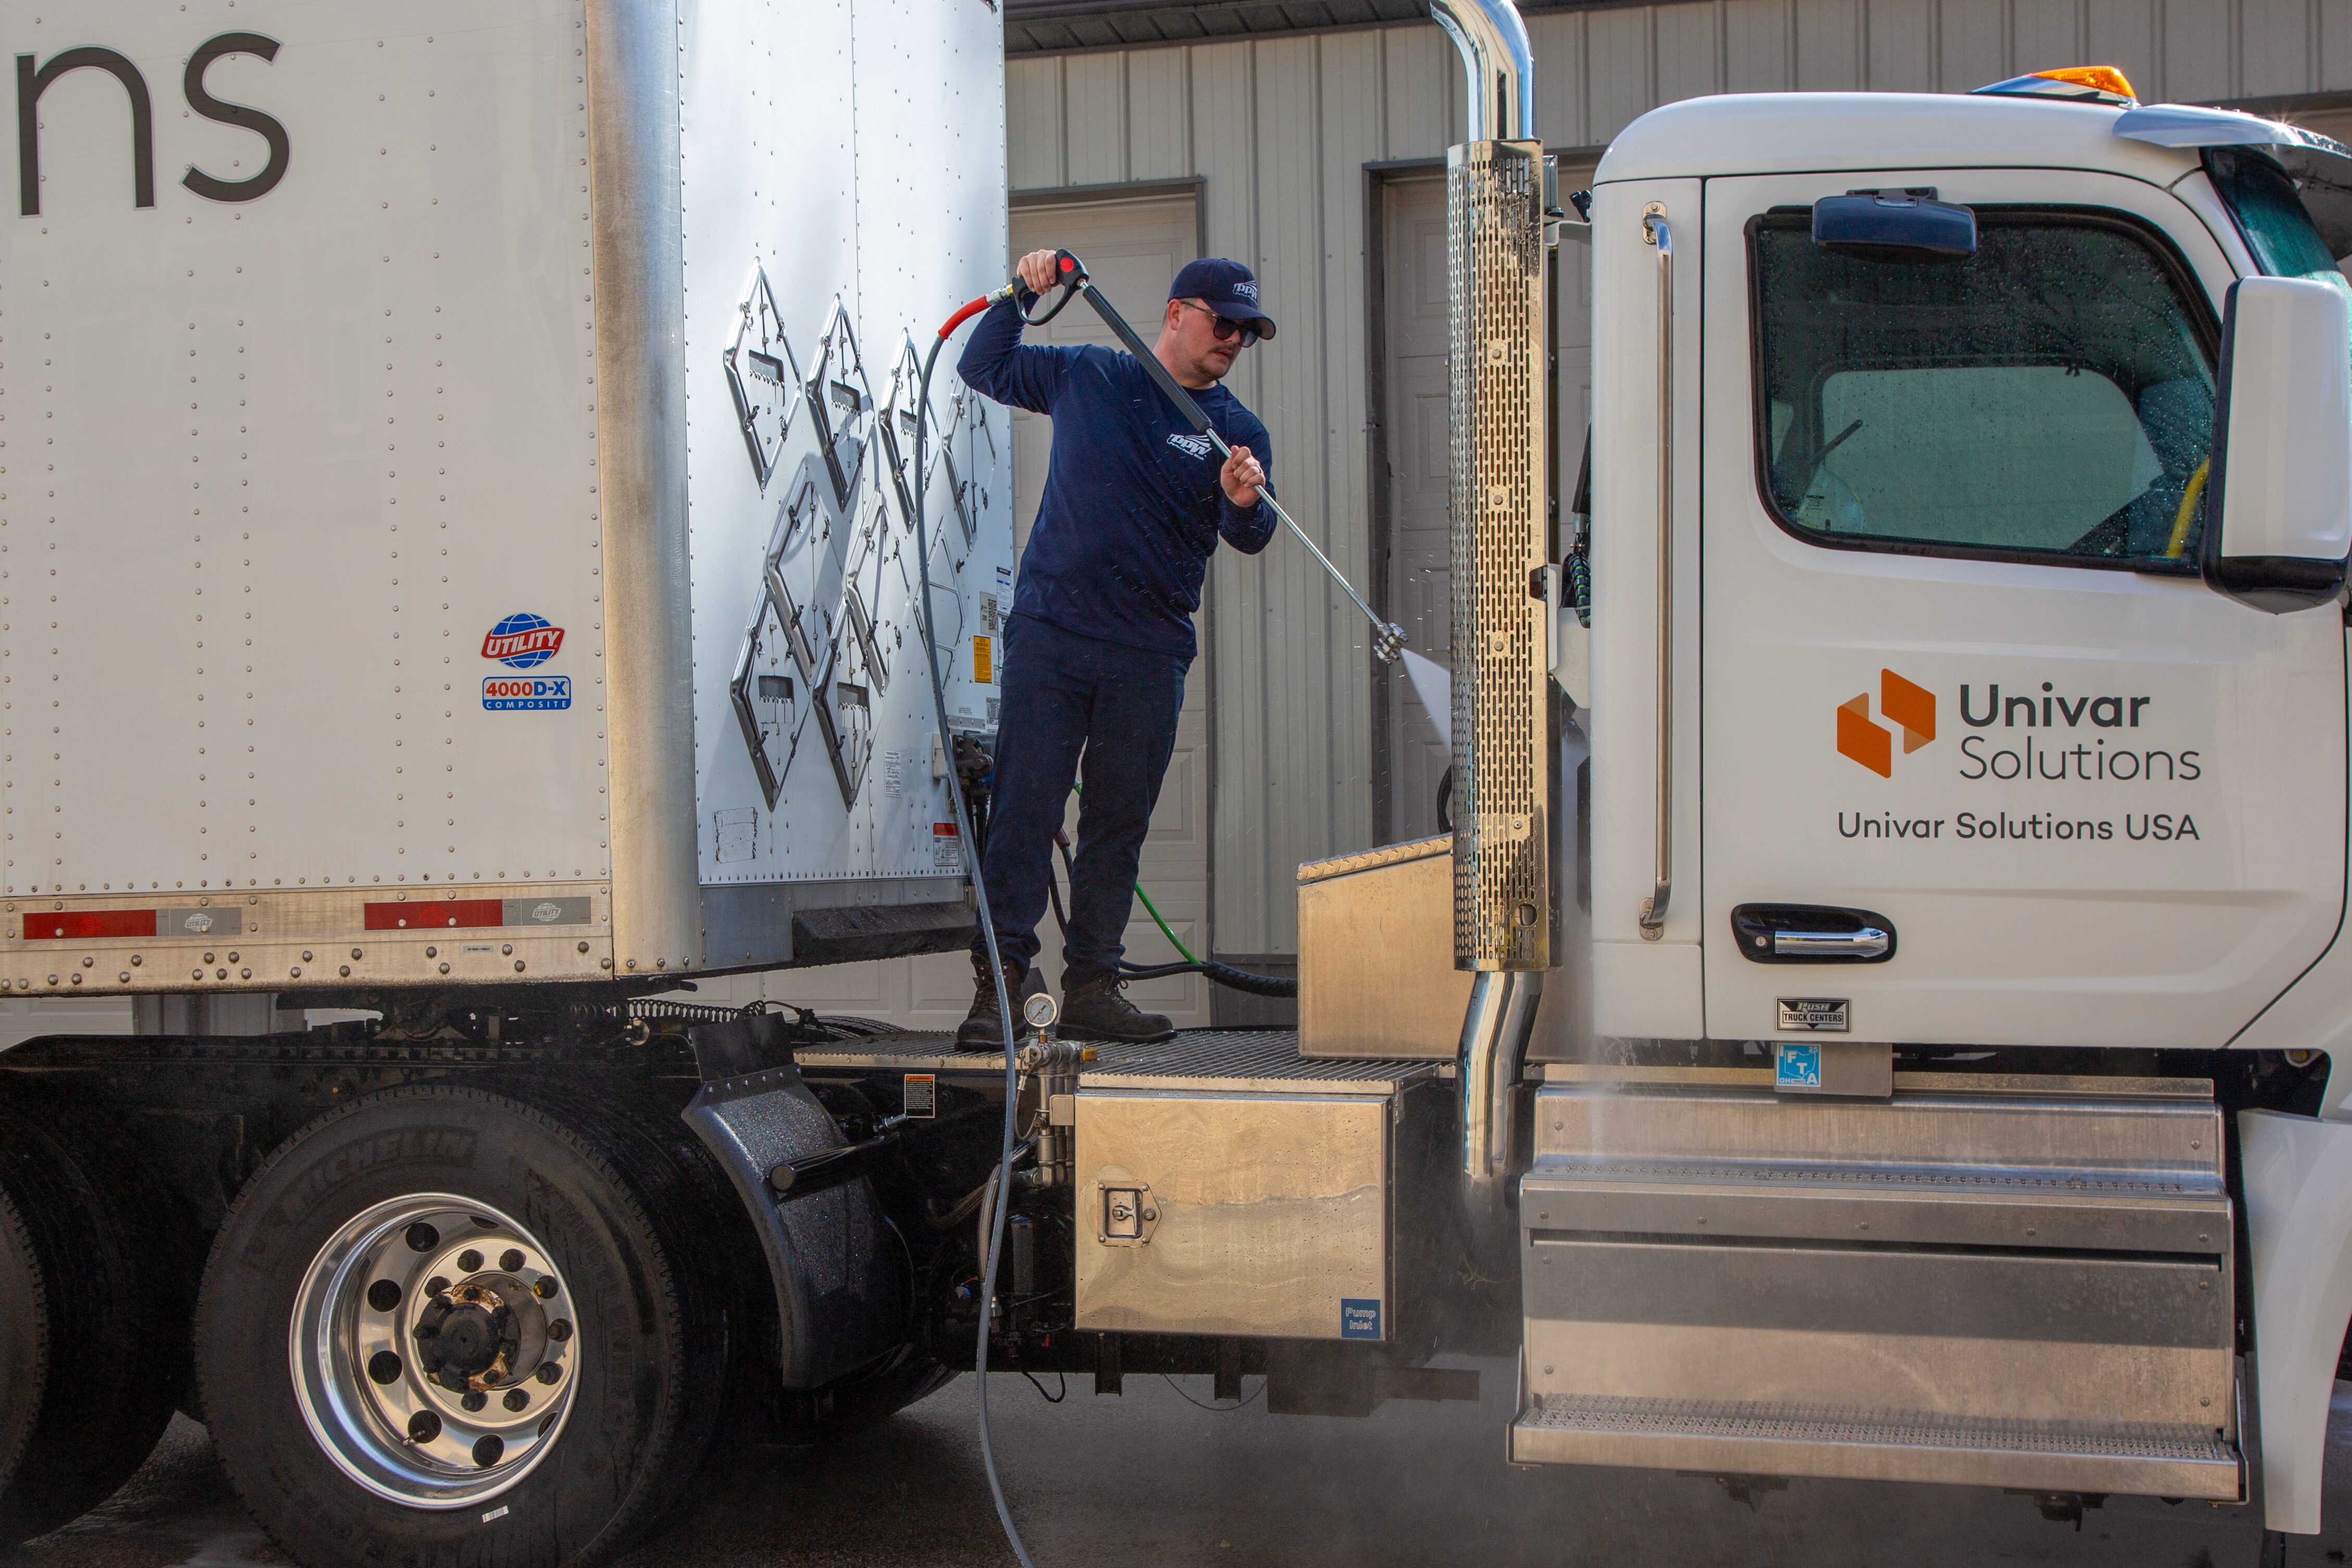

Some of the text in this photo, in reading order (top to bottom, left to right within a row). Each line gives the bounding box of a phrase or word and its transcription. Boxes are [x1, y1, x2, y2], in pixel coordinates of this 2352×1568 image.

[487, 631, 561, 655] UTILITY
[486, 680, 566, 697] 4000D-X
[486, 700, 567, 708] COMPOSITE
[1959, 681, 2150, 727] Univar
[1959, 735, 2202, 781] Solutions
[1838, 811, 2200, 841] Univar Solutions USA
[1810, 1014, 1843, 1022] CENTERS
[1346, 1307, 1376, 1320] Pump
[1349, 1320, 1373, 1330] Inlet
